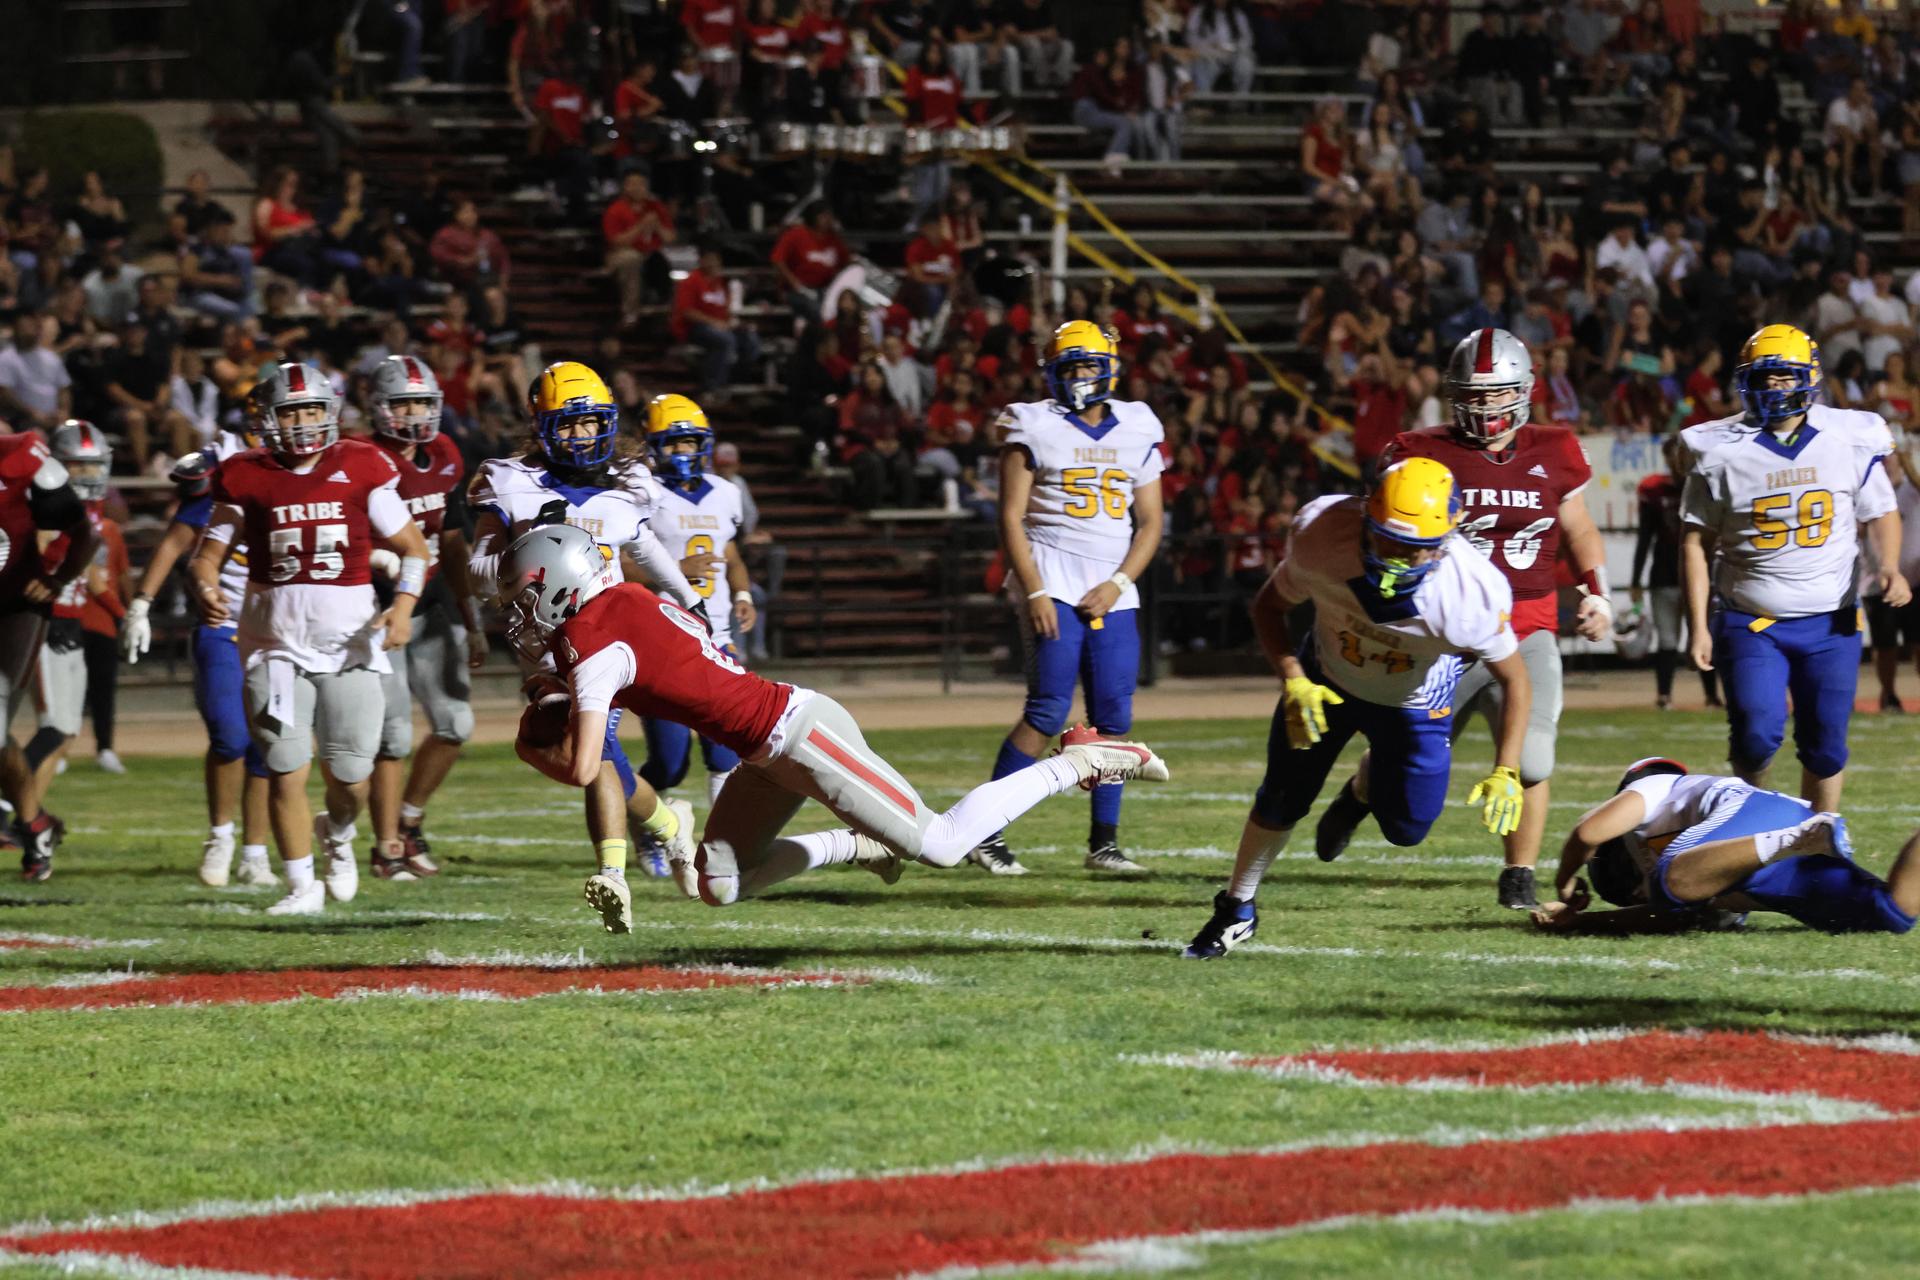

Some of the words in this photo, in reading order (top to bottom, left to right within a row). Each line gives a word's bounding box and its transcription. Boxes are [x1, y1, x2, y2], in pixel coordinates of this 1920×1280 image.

[1061, 467, 1130, 519] 56
[1765, 466, 1818, 490] PARLIER
[272, 501, 346, 524] TRIBE
[1462, 488, 1543, 509] TRIBE
[1748, 489, 1834, 550] 58
[271, 524, 349, 582] 55
